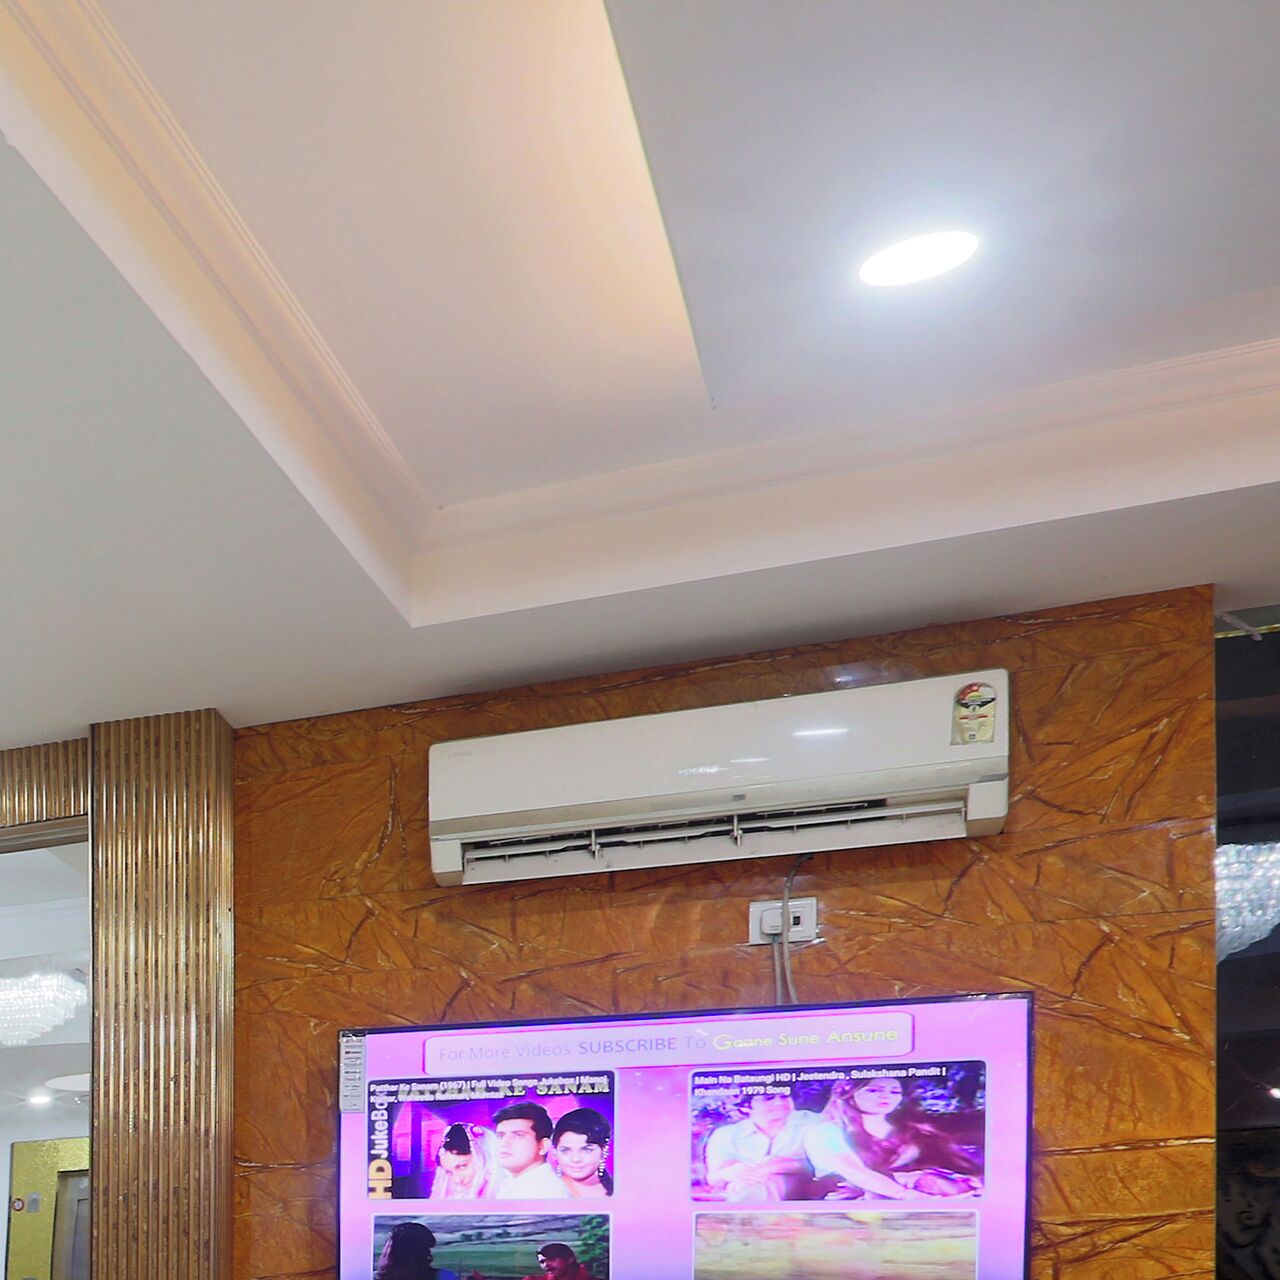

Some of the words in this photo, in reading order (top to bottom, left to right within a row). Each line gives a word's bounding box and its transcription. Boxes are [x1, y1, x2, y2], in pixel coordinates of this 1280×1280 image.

[469, 1046, 510, 1060] More
[516, 1042, 570, 1057] Videos
[579, 1036, 677, 1055] SUBSCRIBE
[778, 1031, 819, 1046] Sune
